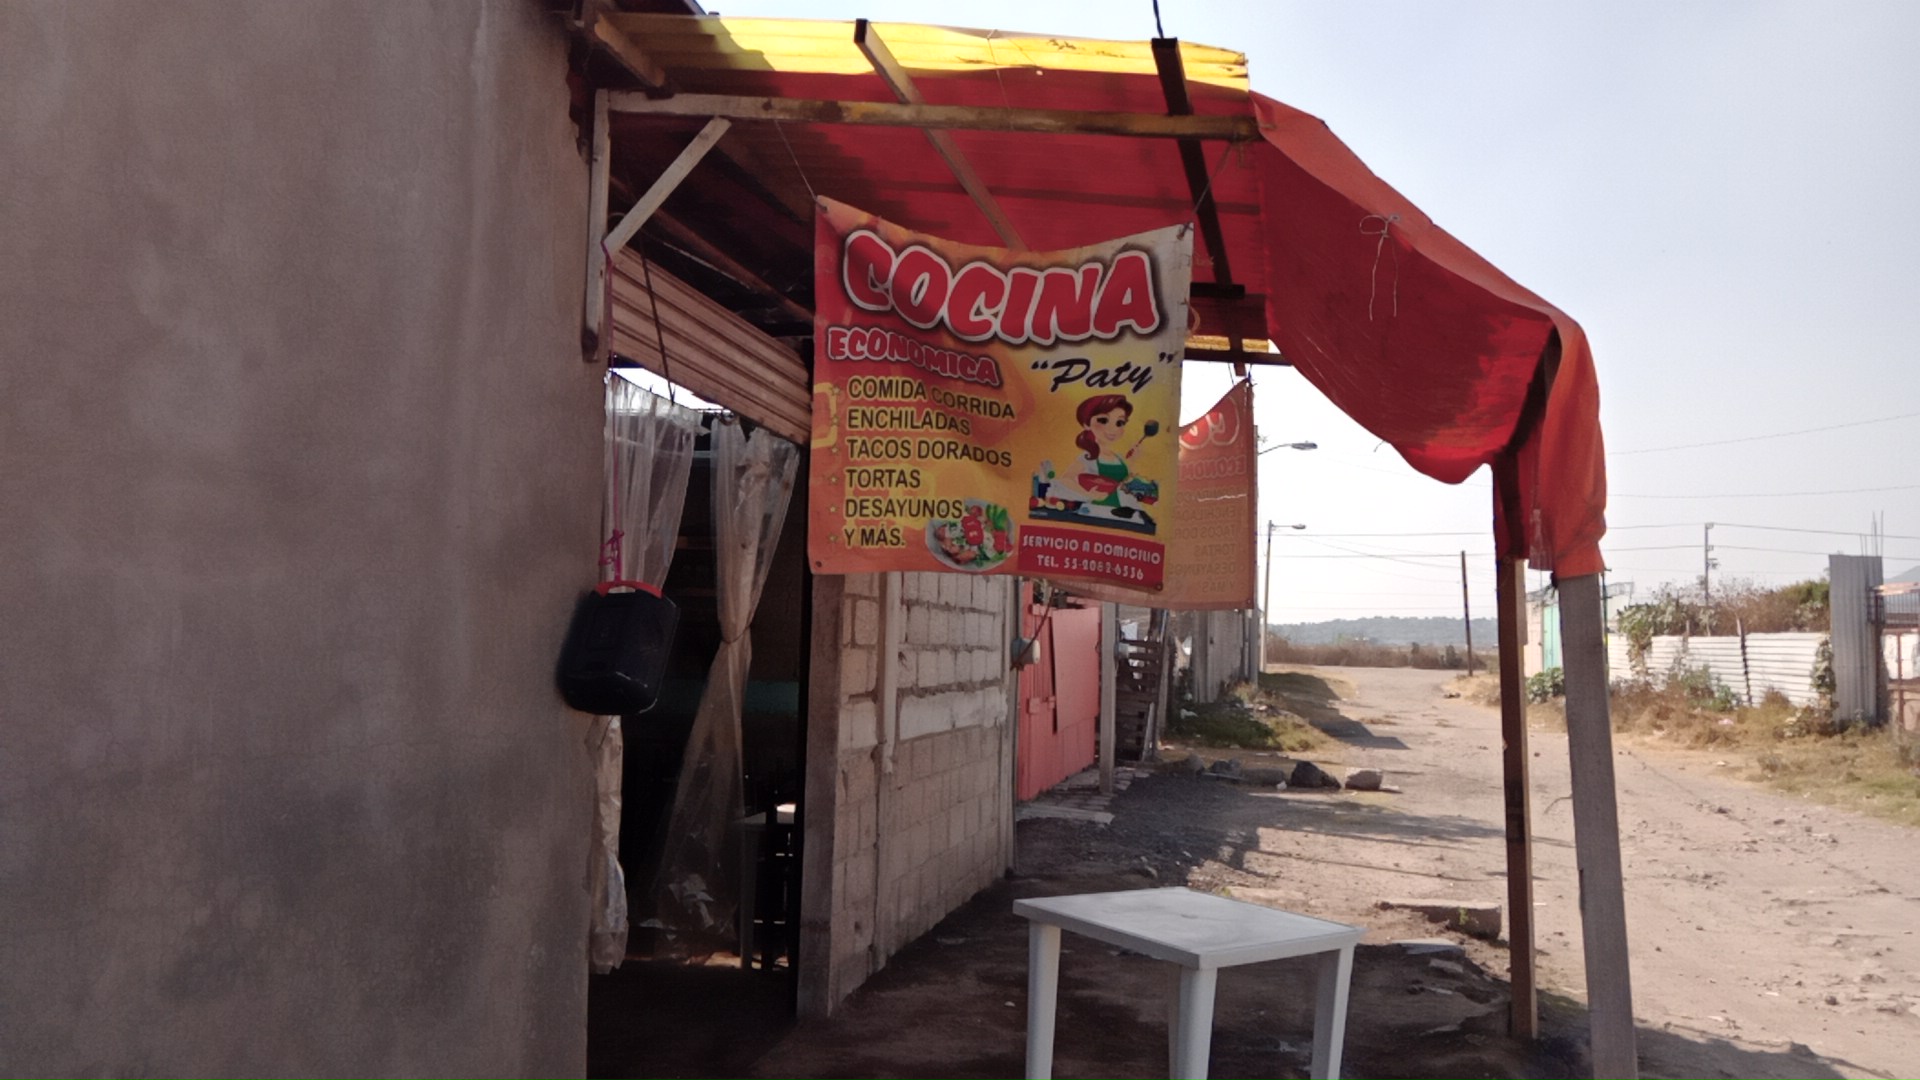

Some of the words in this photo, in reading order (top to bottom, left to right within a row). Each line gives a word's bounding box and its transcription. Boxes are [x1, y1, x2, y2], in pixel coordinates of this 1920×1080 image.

[843, 230, 1159, 345] COCINA
[828, 327, 1000, 386] ECONOMICA
[849, 378, 926, 400] COMIDA
[932, 387, 1015, 419] CORRIDA
[848, 409, 970, 435] ENCHILADAS
[847, 439, 911, 459] TACOS
[917, 440, 1012, 467] DORADOS
[847, 469, 920, 488] TORTAS
[846, 498, 962, 518] DESAYUNOS
[844, 528, 855, 546] Y
[860, 523, 905, 546] MÁS.
[1023, 535, 1079, 551] SERVICIO
[1082, 540, 1090, 552] A
[1094, 542, 1160, 564] DOMICILIO
[1037, 554, 1059, 567] TEL.
